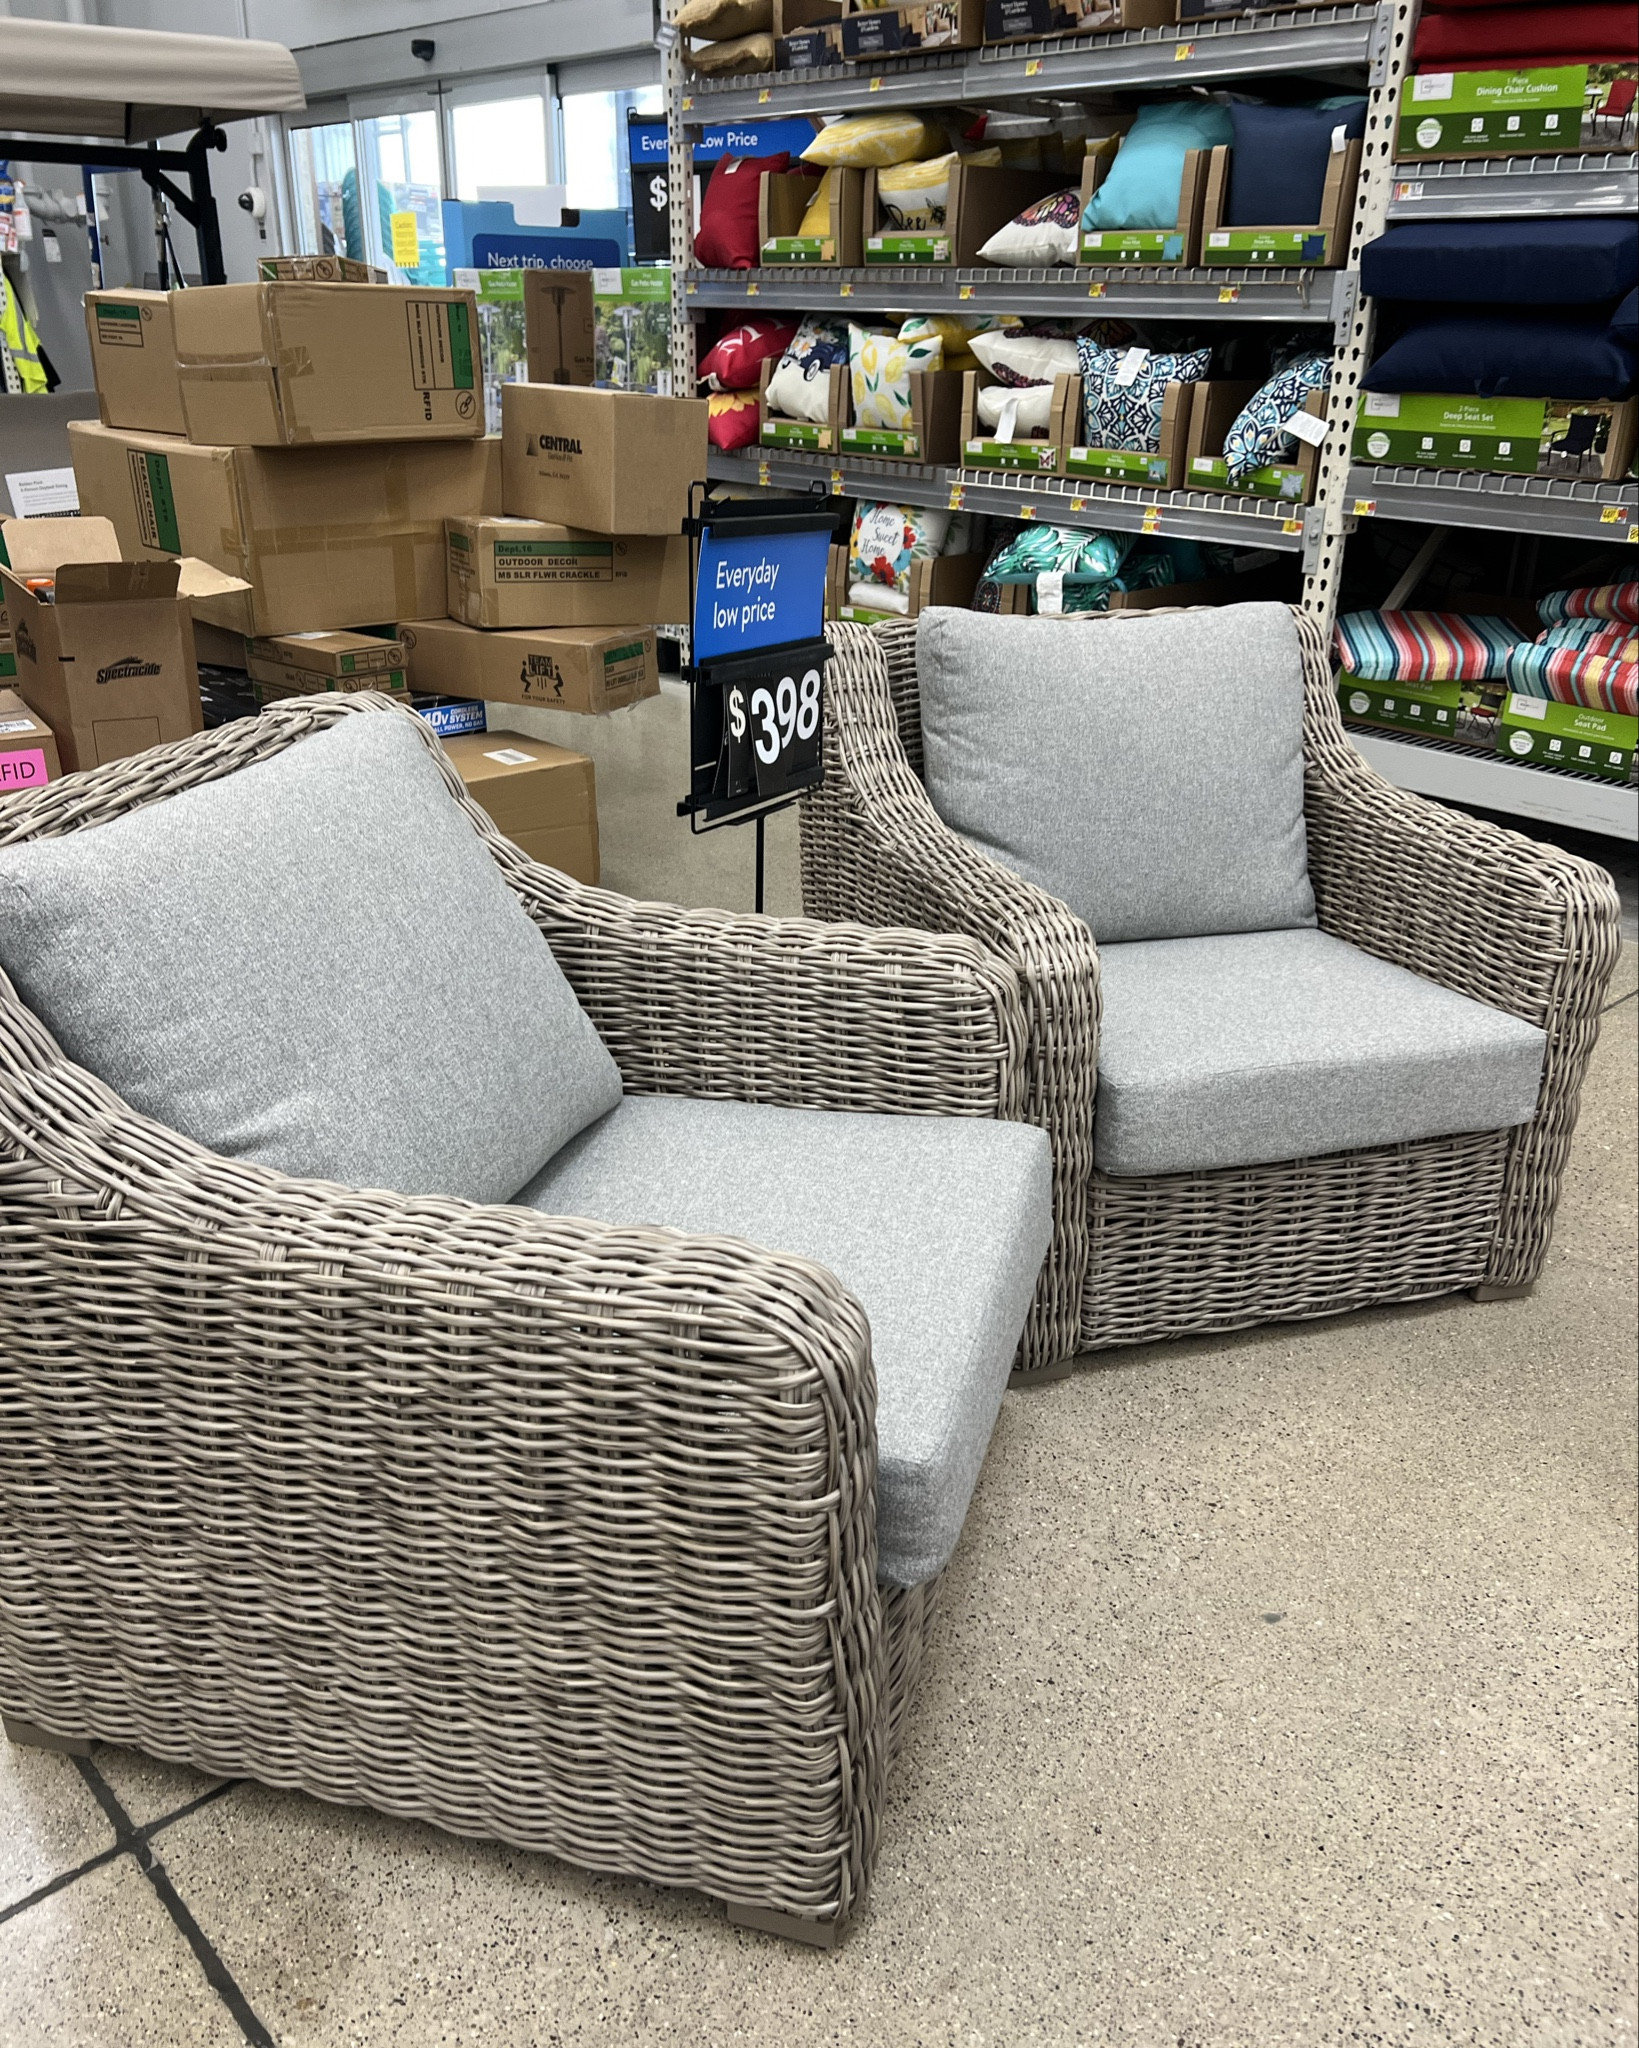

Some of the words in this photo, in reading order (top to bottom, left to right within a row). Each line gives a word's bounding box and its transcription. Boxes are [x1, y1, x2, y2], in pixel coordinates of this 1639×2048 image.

[1476, 85, 1502, 97] Dining
[1503, 84, 1526, 95] Chair
[1526, 82, 1558, 94] Cushion
[726, 131, 759, 147] Price
[649, 175, 668, 212] $
[487, 252, 519, 268] Next
[550, 255, 594, 269] choose
[422, 391, 433, 421] RFID
[1443, 411, 1462, 422] Deep
[1463, 412, 1481, 422] Seat
[1482, 413, 1494, 422] Set
[539, 434, 583, 455] CENTRAL
[139, 456, 151, 498] BEACH
[146, 501, 158, 539] CHAIR
[869, 509, 896, 527] Home
[872, 527, 900, 546] Sweet
[861, 538, 885, 555] Home
[498, 558, 543, 566] OUTDOOR
[548, 557, 578, 566] DECOR
[534, 571, 557, 579] FLWR
[560, 571, 600, 579] CRACKLE
[715, 557, 780, 594] Everyday
[713, 601, 739, 629] low
[740, 596, 776, 633] price
[529, 655, 552, 666] TEAM
[96, 662, 163, 685] Spectracide
[529, 664, 551, 677] LIFT
[449, 711, 483, 724] SYSTEM
[1573, 719, 1590, 729] Seat
[1591, 721, 1607, 732] Pad
[1578, 713, 1605, 724] Outdoor
[0, 761, 35, 782] FID
